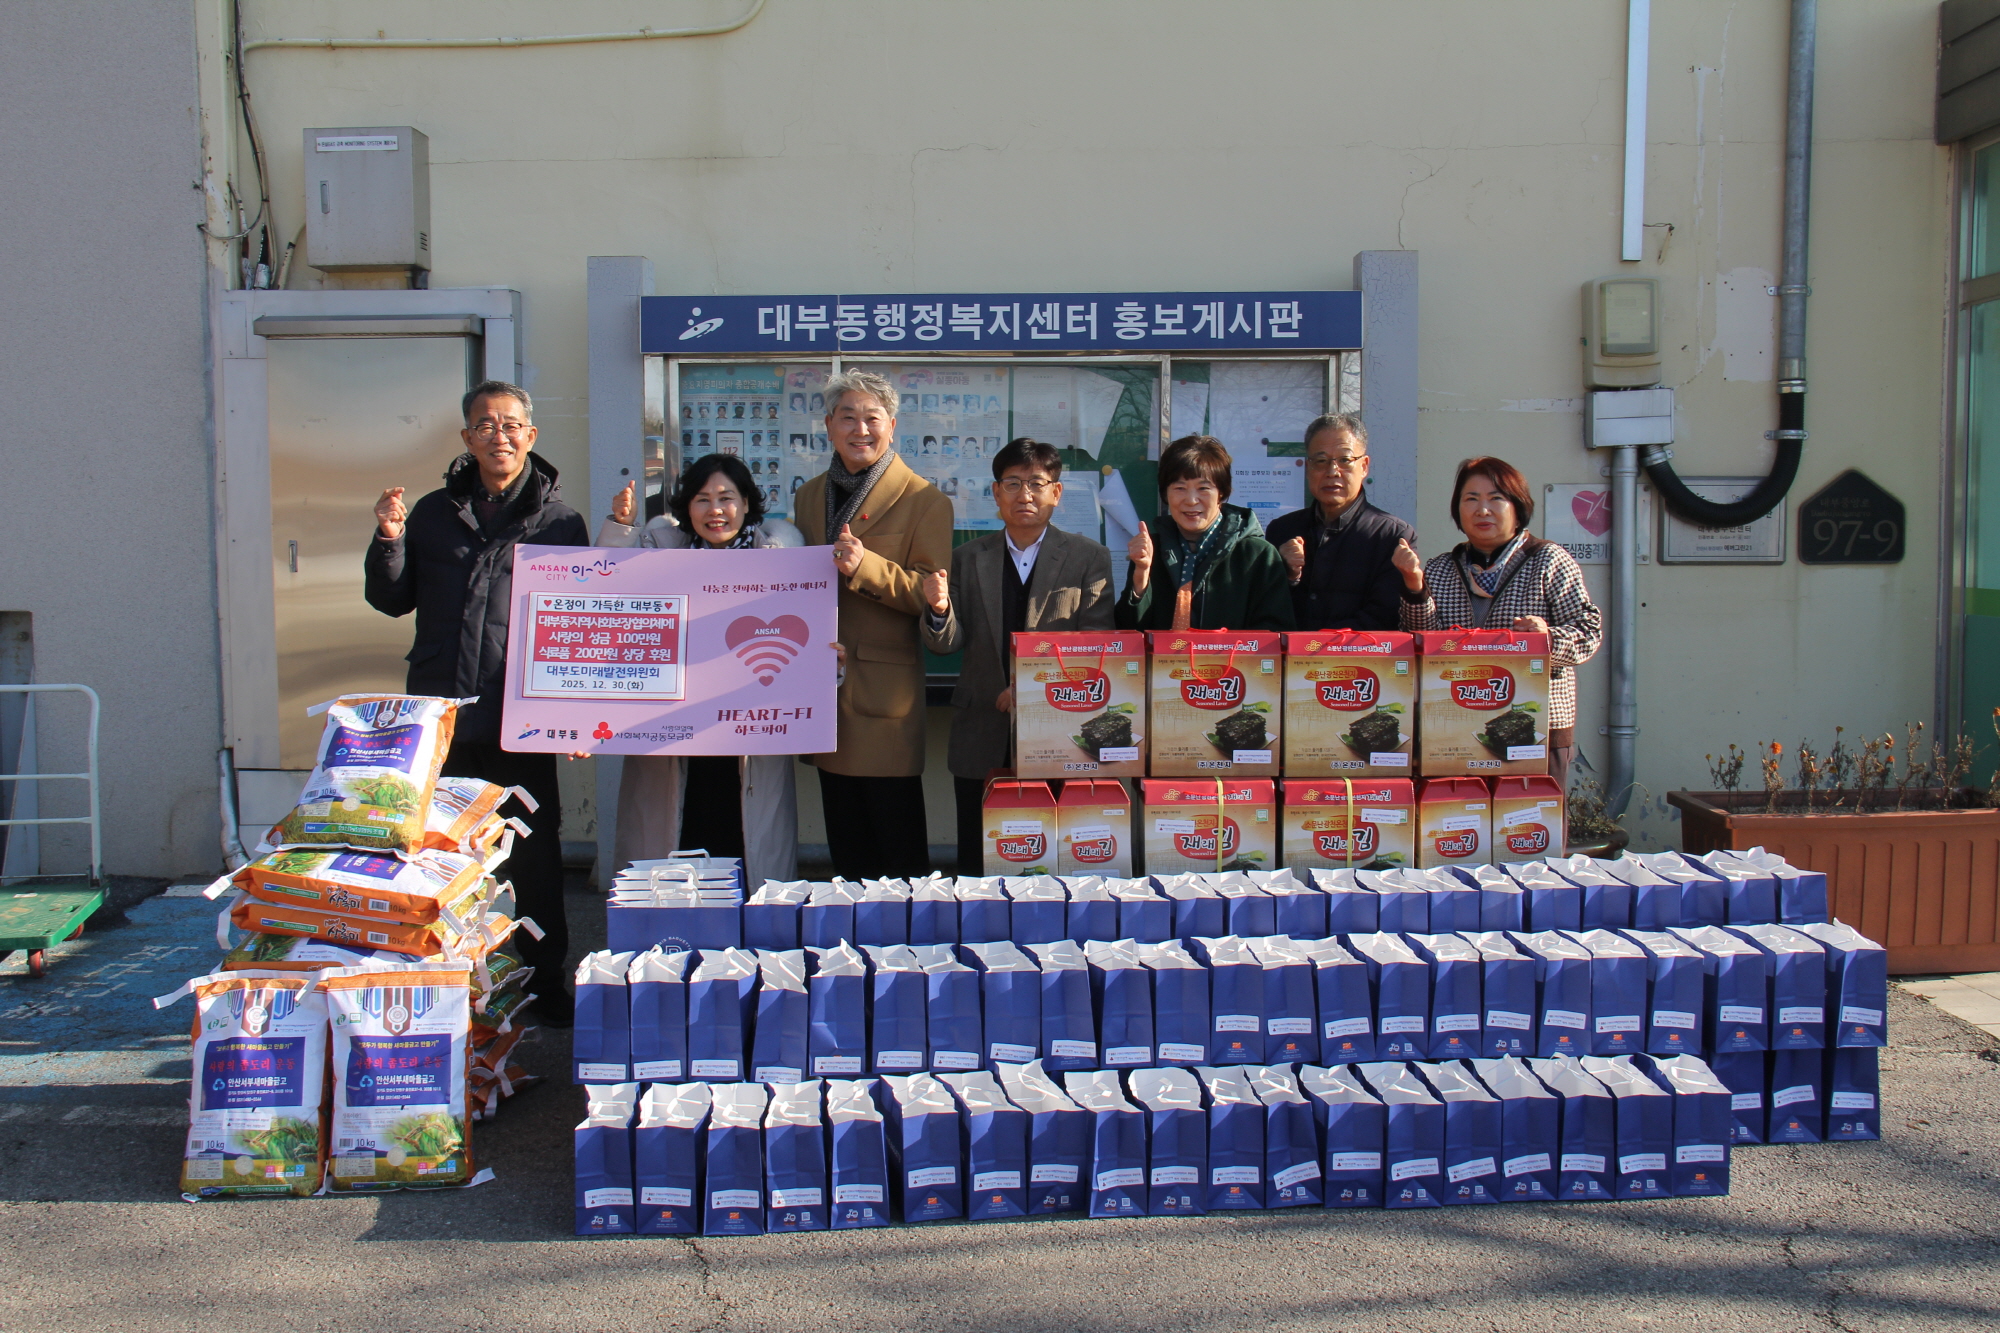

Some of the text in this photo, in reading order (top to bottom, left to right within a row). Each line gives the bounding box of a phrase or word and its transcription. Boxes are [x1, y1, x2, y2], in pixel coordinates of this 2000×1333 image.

[758, 301, 1302, 341] 대부동행정복지센터 홍보게시판
[735, 379, 780, 390] 종합공개수배
[936, 376, 970, 386] 실종아동
[1813, 518, 1899, 557] 97-9
[530, 564, 568, 573] ANSAN
[546, 573, 568, 581] CITY
[702, 584, 729, 593] 나눔을
[731, 584, 768, 593] 전파하는
[800, 580, 828, 590] 에너지
[553, 599, 663, 612] 온정이 가득한 대부동
[538, 615, 675, 630] 대부동지역사회보장협의체에
[549, 631, 661, 645] 사랑의 성금 100만원
[754, 628, 780, 636] ANSAN
[538, 646, 671, 661] 식료품 200만원 상당 후원
[546, 665, 660, 678] 대부도미래발전위원회
[561, 680, 588, 689] 2025.
[592, 680, 607, 689] 12.
[1051, 678, 1105, 703] 재래김
[1187, 676, 1240, 701] 재래김
[1321, 677, 1374, 702] 재래김
[1456, 676, 1510, 701] 재래김
[717, 707, 813, 722] HEART-FI
[734, 723, 787, 736] 하트파이
[614, 731, 694, 742] 사회복지공동모금회
[329, 788, 337, 796] kg
[1180, 826, 1234, 850] 재래김
[1438, 833, 1475, 851] 재래김
[1511, 831, 1545, 849] 재래김
[1001, 836, 1042, 855] 재래김
[1076, 839, 1113, 857] 재래김
[398, 905, 407, 914] kg
[397, 938, 406, 946] kg
[209, 1057, 296, 1072] 사랑의 좀도리 운동
[355, 1055, 445, 1069] 사랑의 좀도리 운동
[228, 1076, 287, 1088] 안산서부새마을금고
[376, 1074, 436, 1085] 안산서부새마을금고
[207, 1140, 225, 1150] 10 kg
[356, 1138, 376, 1148] 10 kg
